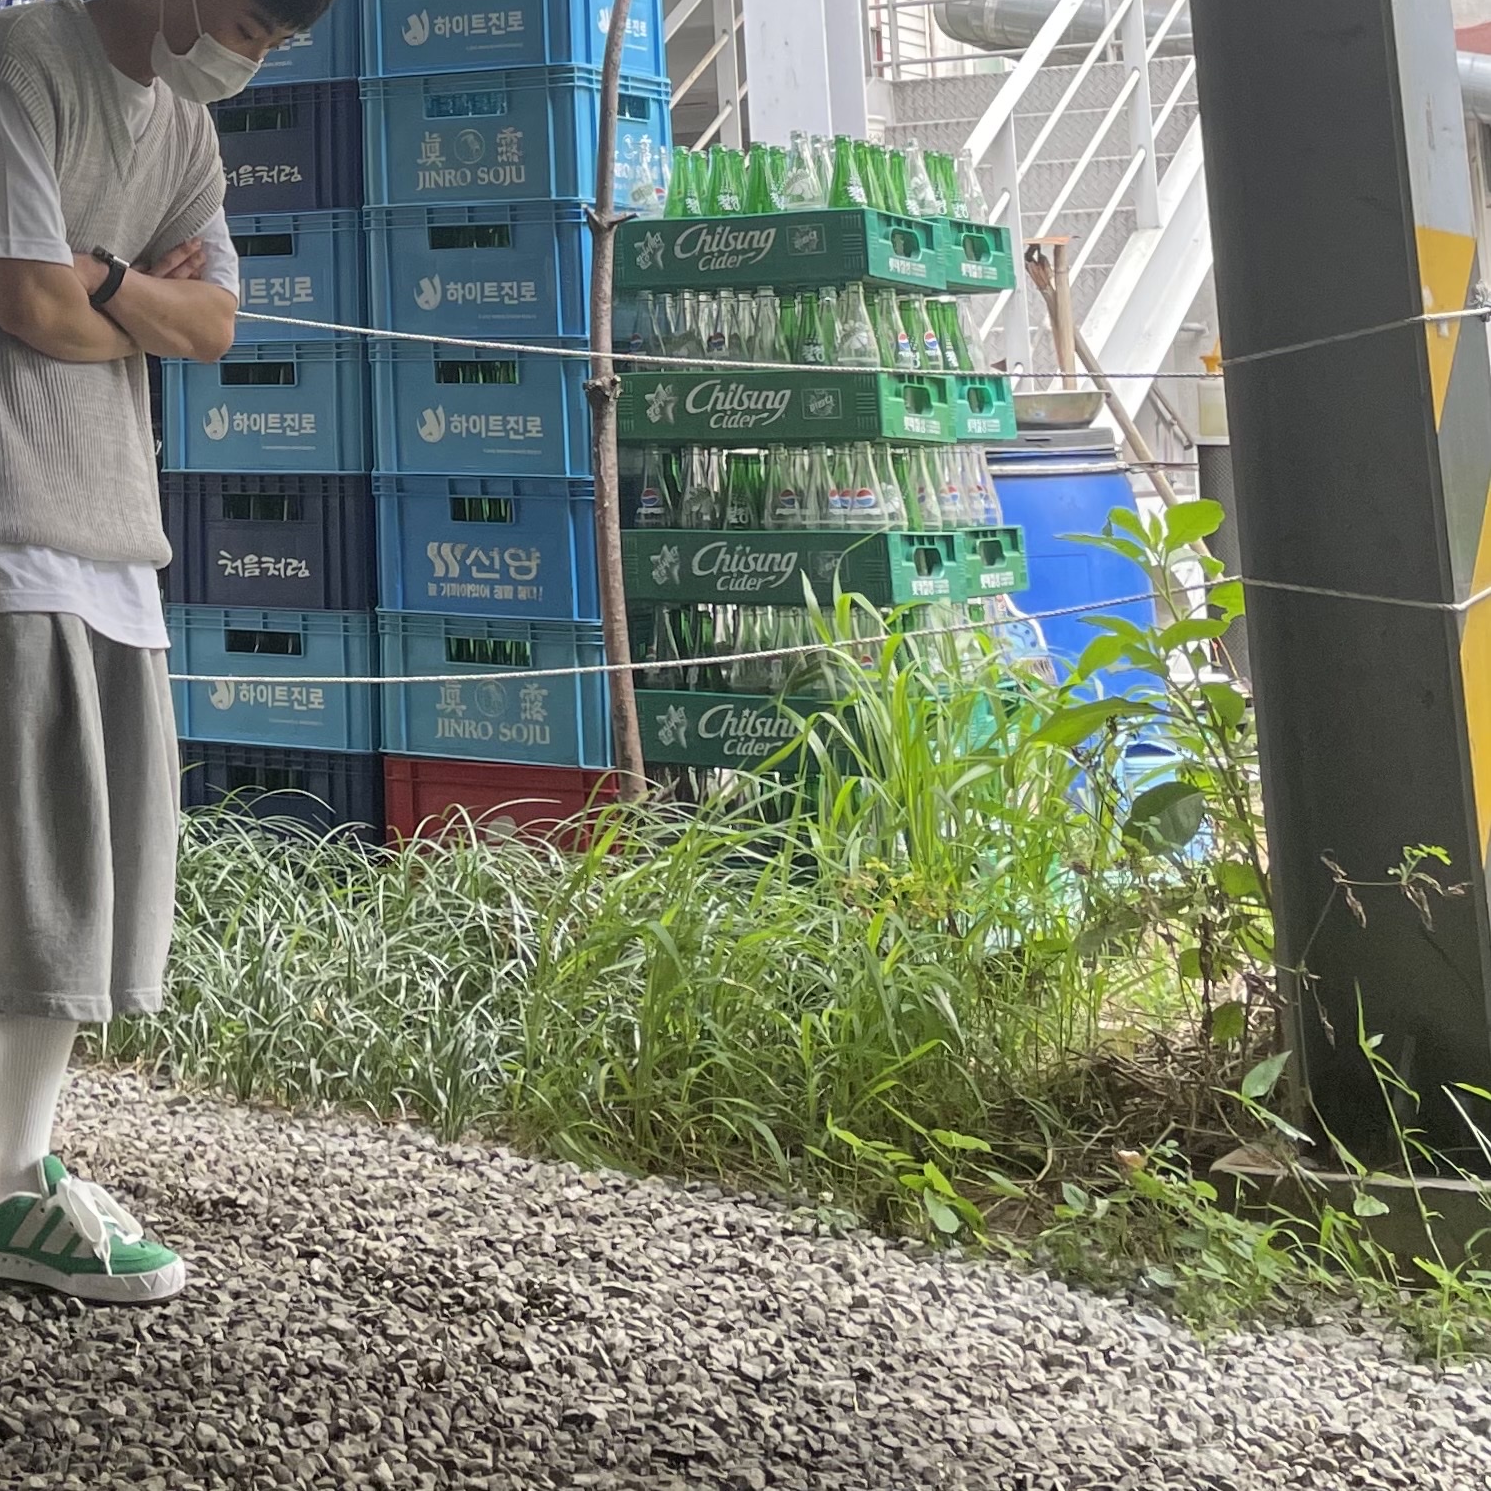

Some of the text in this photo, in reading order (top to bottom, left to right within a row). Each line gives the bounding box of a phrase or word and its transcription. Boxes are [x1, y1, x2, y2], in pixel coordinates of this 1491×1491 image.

[433, 10, 525, 39] 하이트진로
[415, 165, 526, 191] JINRO SOJU
[673, 223, 778, 265] Chilsung
[239, 275, 314, 306] 트진로
[446, 279, 538, 306] 하이트진로
[684, 378, 792, 423] Chilsung
[231, 411, 317, 436] 하이트진로
[449, 413, 545, 440] 하이트진로
[217, 550, 311, 579] 처음처럼
[465, 545, 542, 581] 선양
[691, 540, 798, 587] Chilsung
[237, 682, 326, 711] 하이트진로
[434, 716, 552, 746] JINRO SOJU
[697, 703, 801, 741] Chilsun
